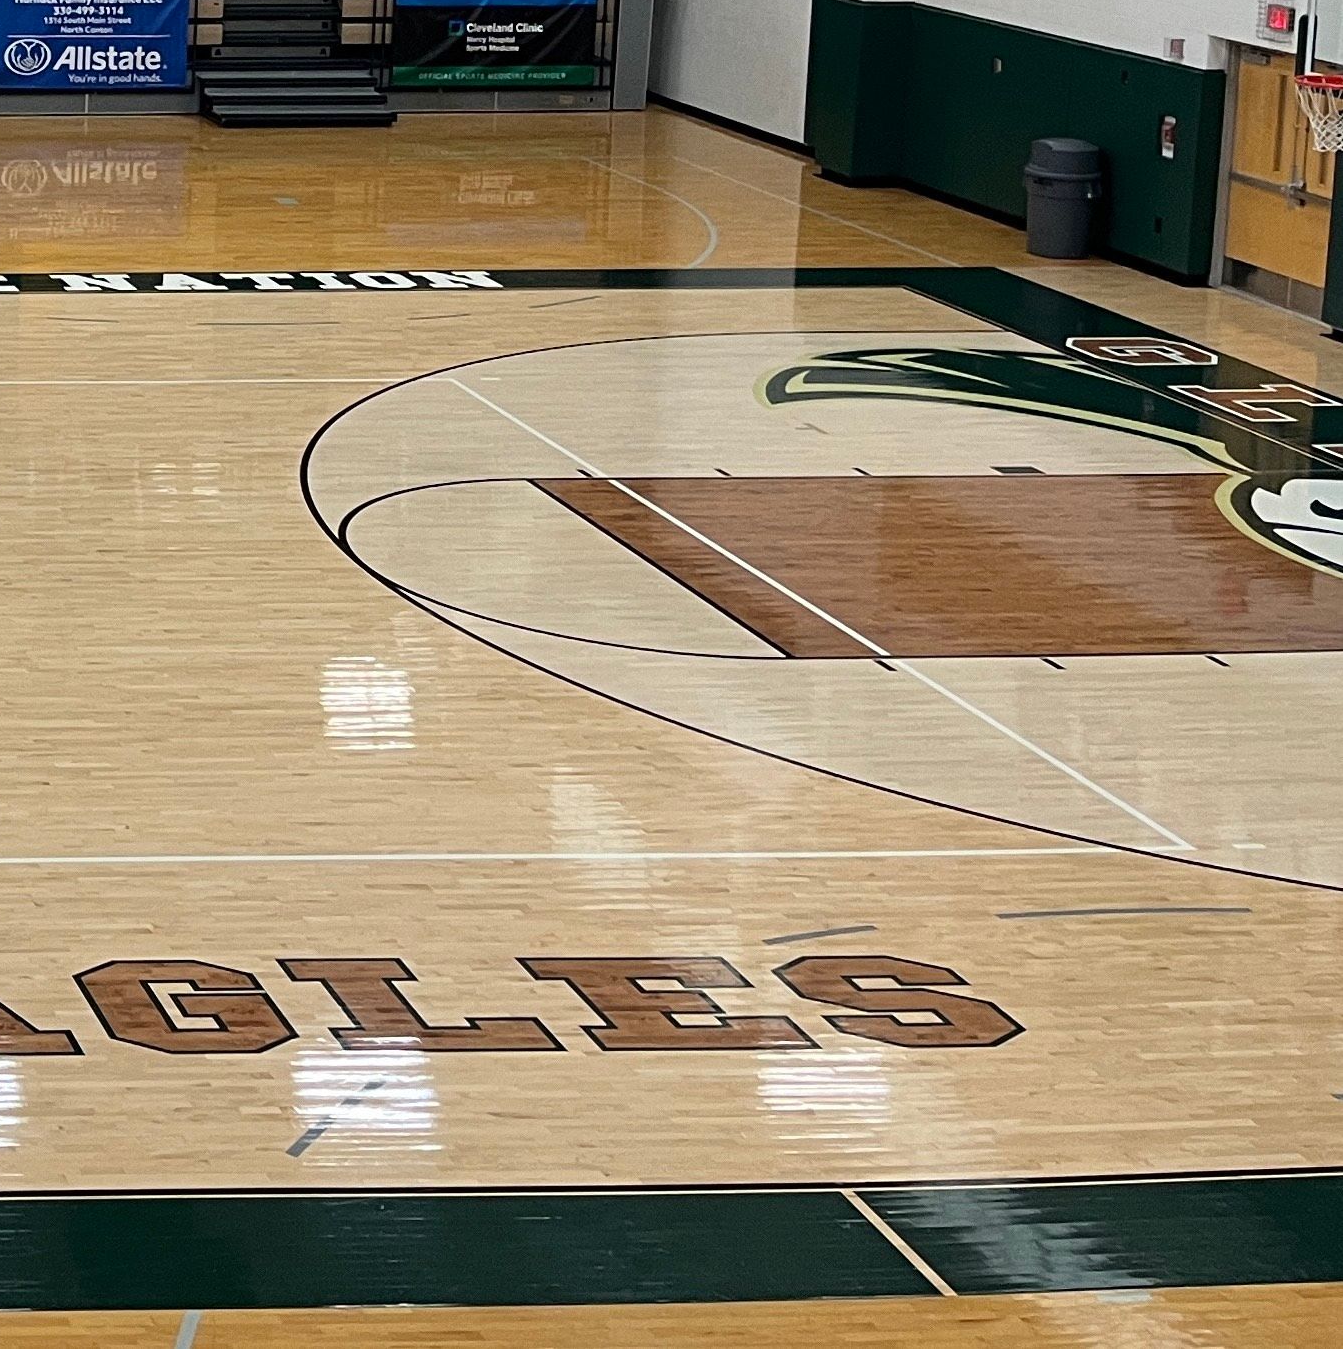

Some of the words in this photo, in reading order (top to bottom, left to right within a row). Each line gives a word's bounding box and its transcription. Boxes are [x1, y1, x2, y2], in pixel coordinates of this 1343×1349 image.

[466, 23, 513, 33] Cleveland
[516, 23, 544, 33] Clinic
[53, 46, 161, 71] Allstate
[98, 73, 107, 82] in
[108, 74, 131, 84] good
[46, 269, 504, 292] NATION
